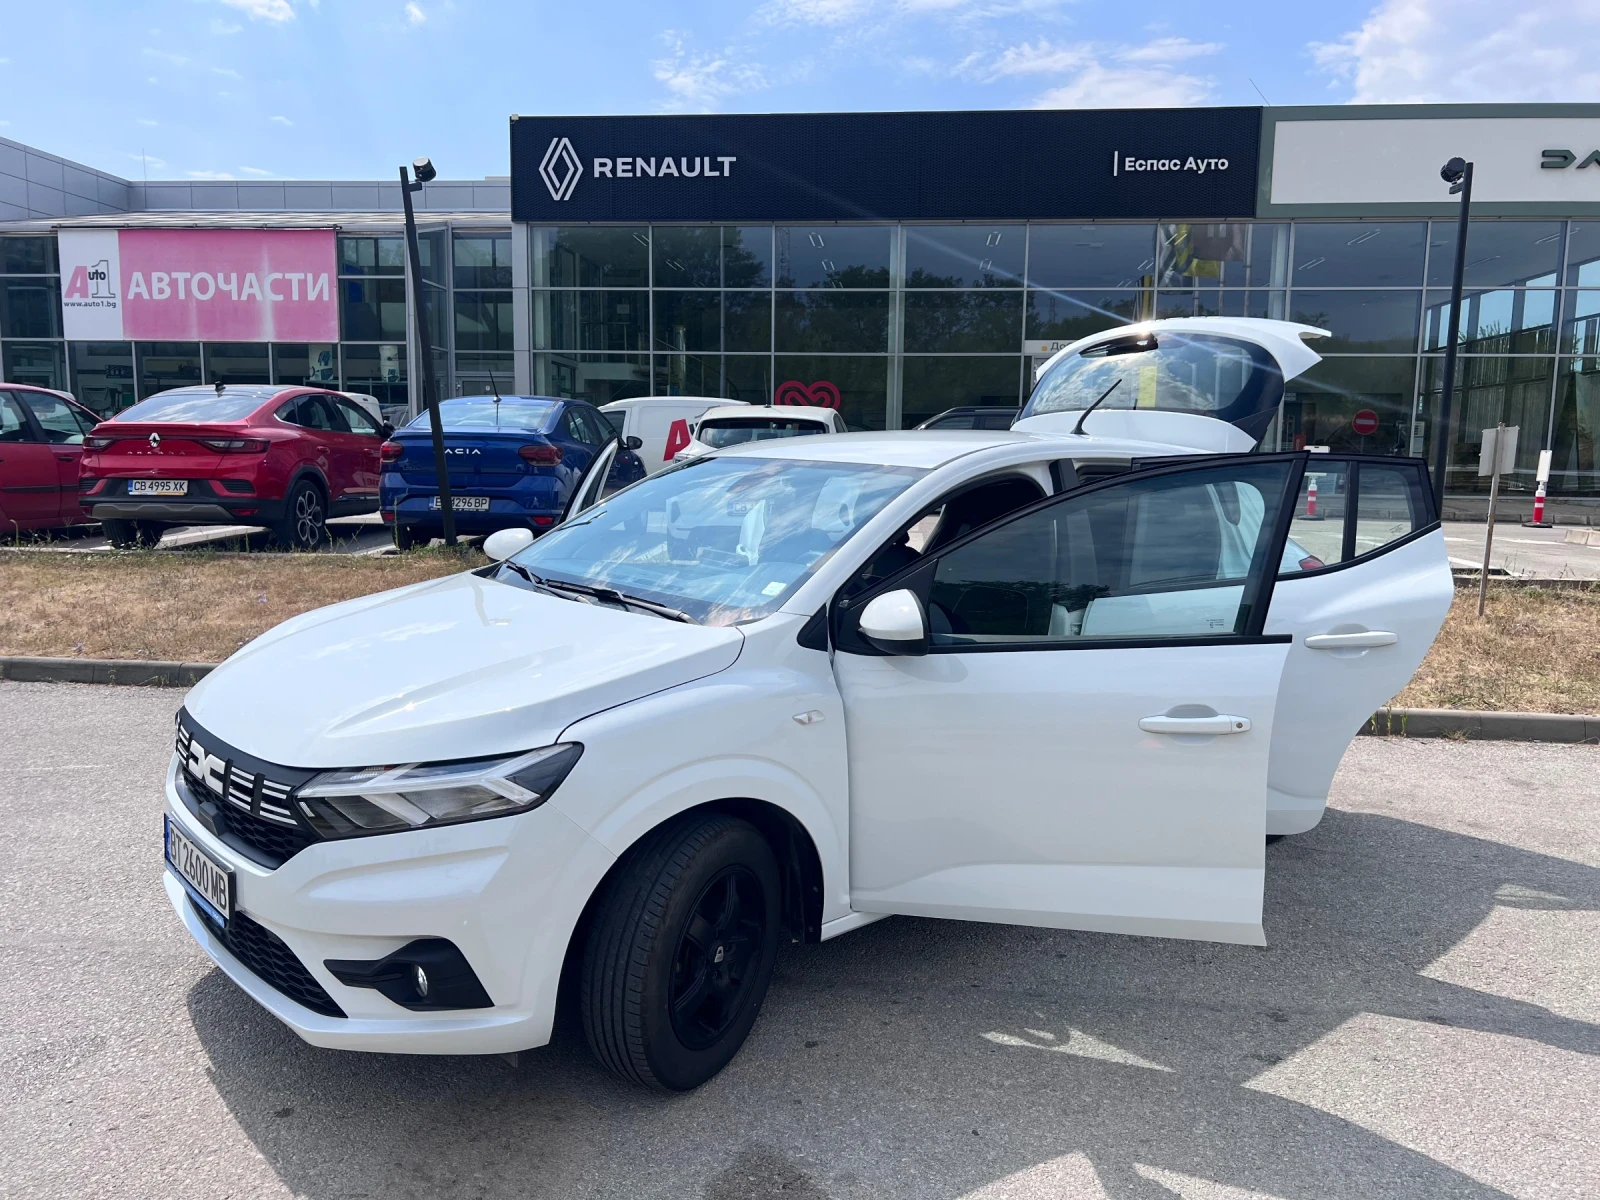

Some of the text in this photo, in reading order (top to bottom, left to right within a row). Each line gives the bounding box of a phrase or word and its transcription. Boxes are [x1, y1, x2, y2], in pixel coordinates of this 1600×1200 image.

[593, 156, 737, 178] RENAULT
[1125, 156, 1229, 174] Еспас Ауто
[127, 271, 330, 301] АВТОЧАСТИ
[63, 300, 117, 309] www.auto1.bg
[1050, 342, 1074, 352] До
[148, 481, 171, 491] 4995
[183, 842, 209, 893] 2600
